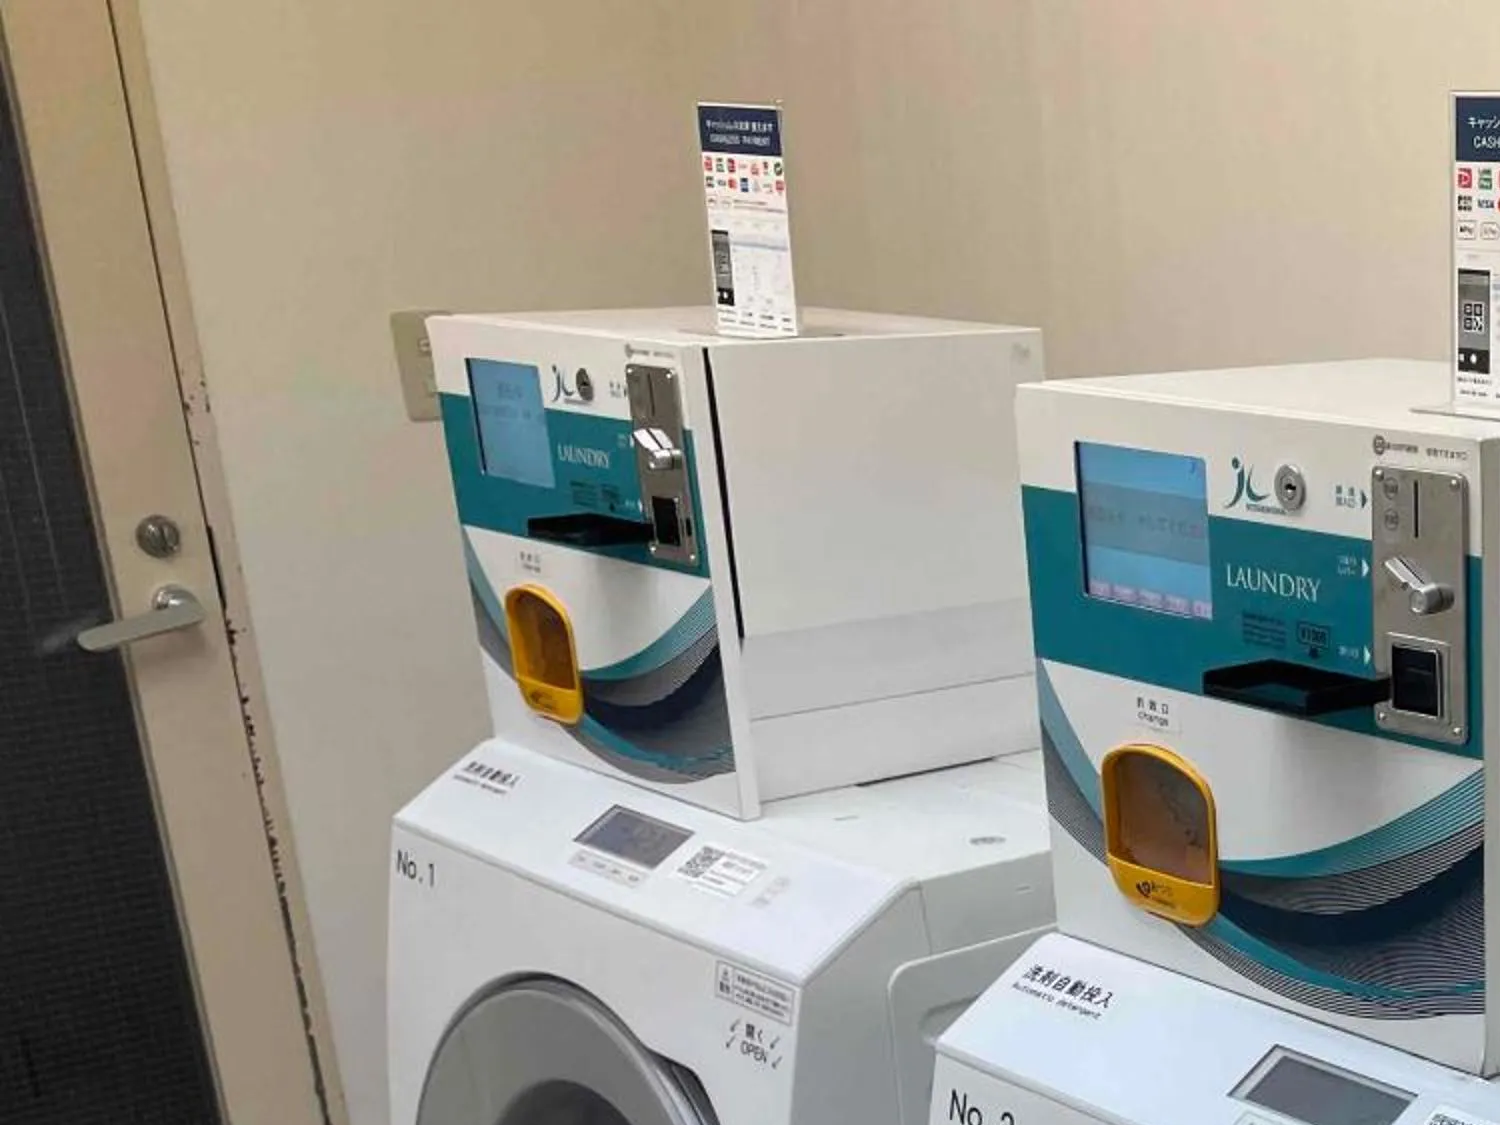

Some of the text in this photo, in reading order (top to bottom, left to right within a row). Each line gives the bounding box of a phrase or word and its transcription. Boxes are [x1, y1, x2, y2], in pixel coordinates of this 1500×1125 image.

[557, 442, 610, 469] LAUNDRY
[1226, 563, 1321, 602] LAUNDRY
[1022, 963, 1113, 1008] 洗剤自動投入
